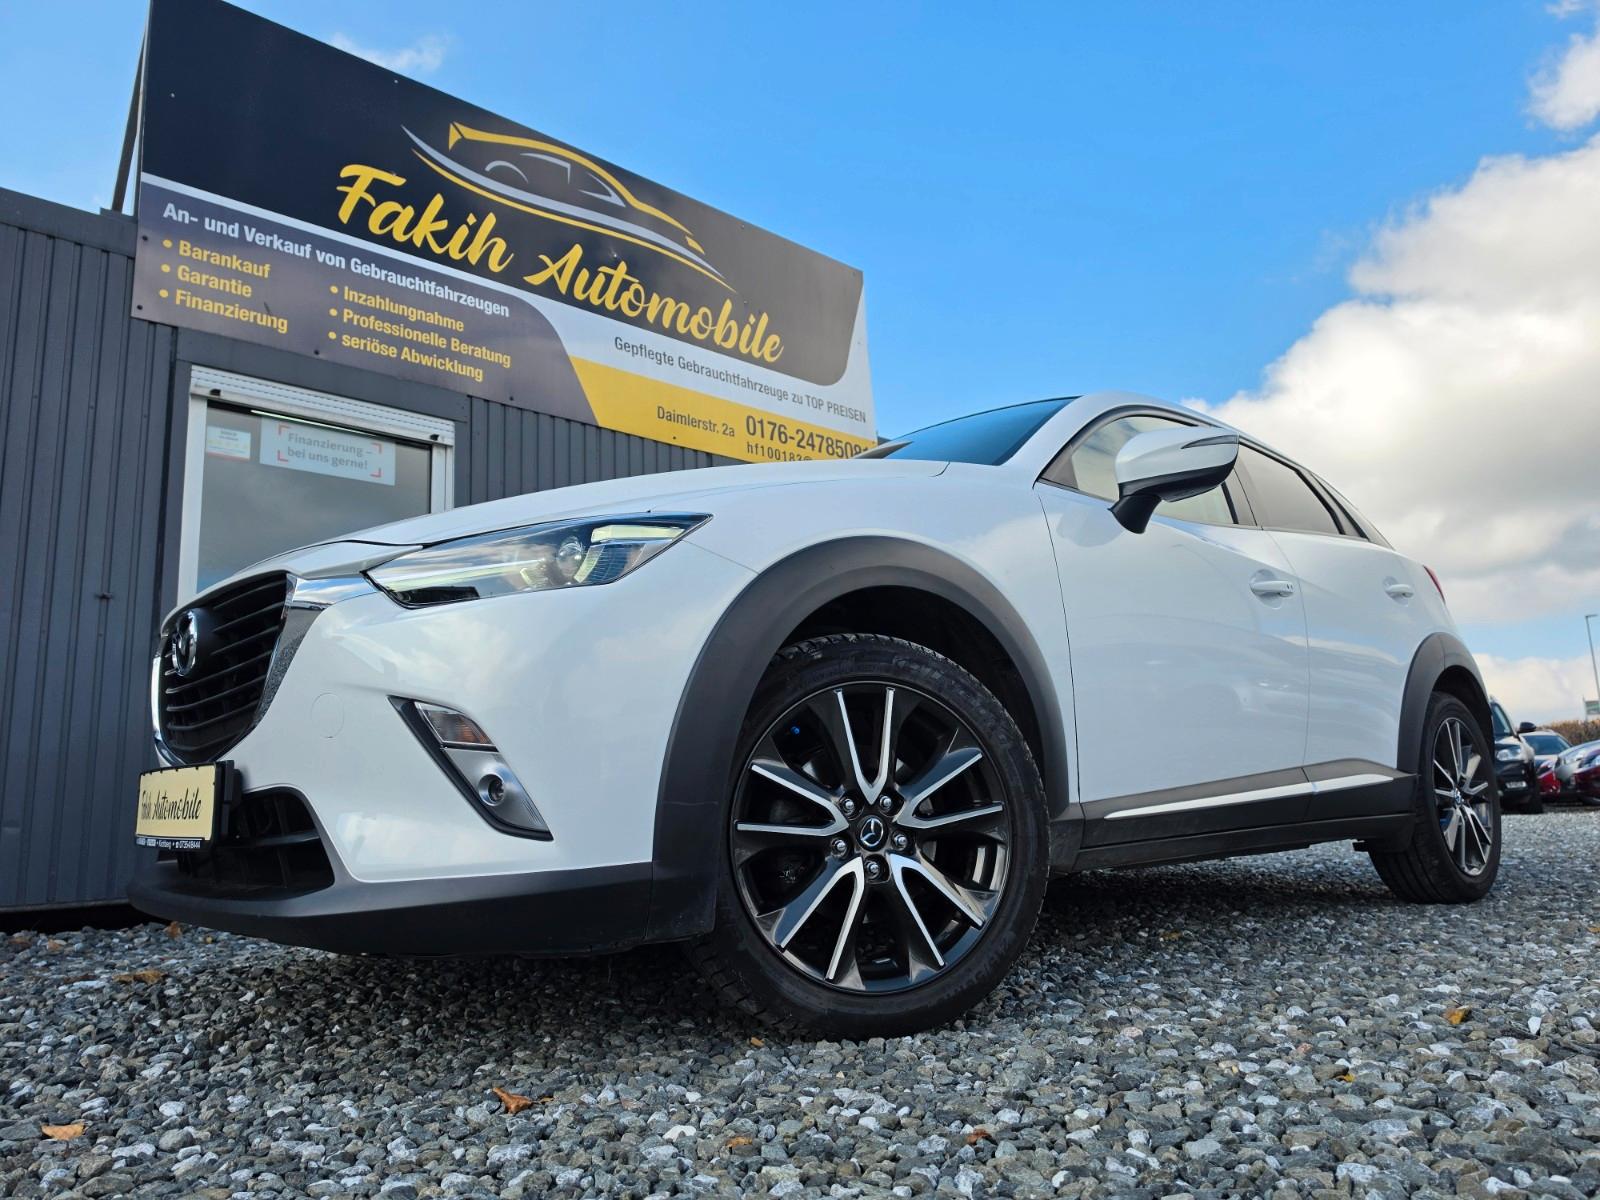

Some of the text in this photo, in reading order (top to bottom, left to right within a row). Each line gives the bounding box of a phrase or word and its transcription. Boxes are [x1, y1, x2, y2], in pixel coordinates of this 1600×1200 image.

[163, 202, 510, 319] An- und Verkauf von Gebrauchtfahrzeugen
[177, 265, 252, 299] Garantie
[178, 240, 271, 279] Barankauf
[336, 163, 785, 364] Fakih Automobile
[175, 289, 289, 335] Finanzierung
[343, 285, 465, 332] Inzahlungnahme
[341, 333, 484, 383] seriöse Abwicklung
[343, 308, 512, 369] Professionelle Beratung
[614, 336, 867, 424] Gepflegte Gebrauchtfahrzeuge zu TOP PREISEN
[657, 405, 736, 438] Daimlerstr. 2a
[745, 415, 869, 460] 0176-2478508
[287, 432, 363, 457] Finanzierung
[287, 446, 368, 470] bei uns gerne!
[152, 787, 202, 820] Automobile
